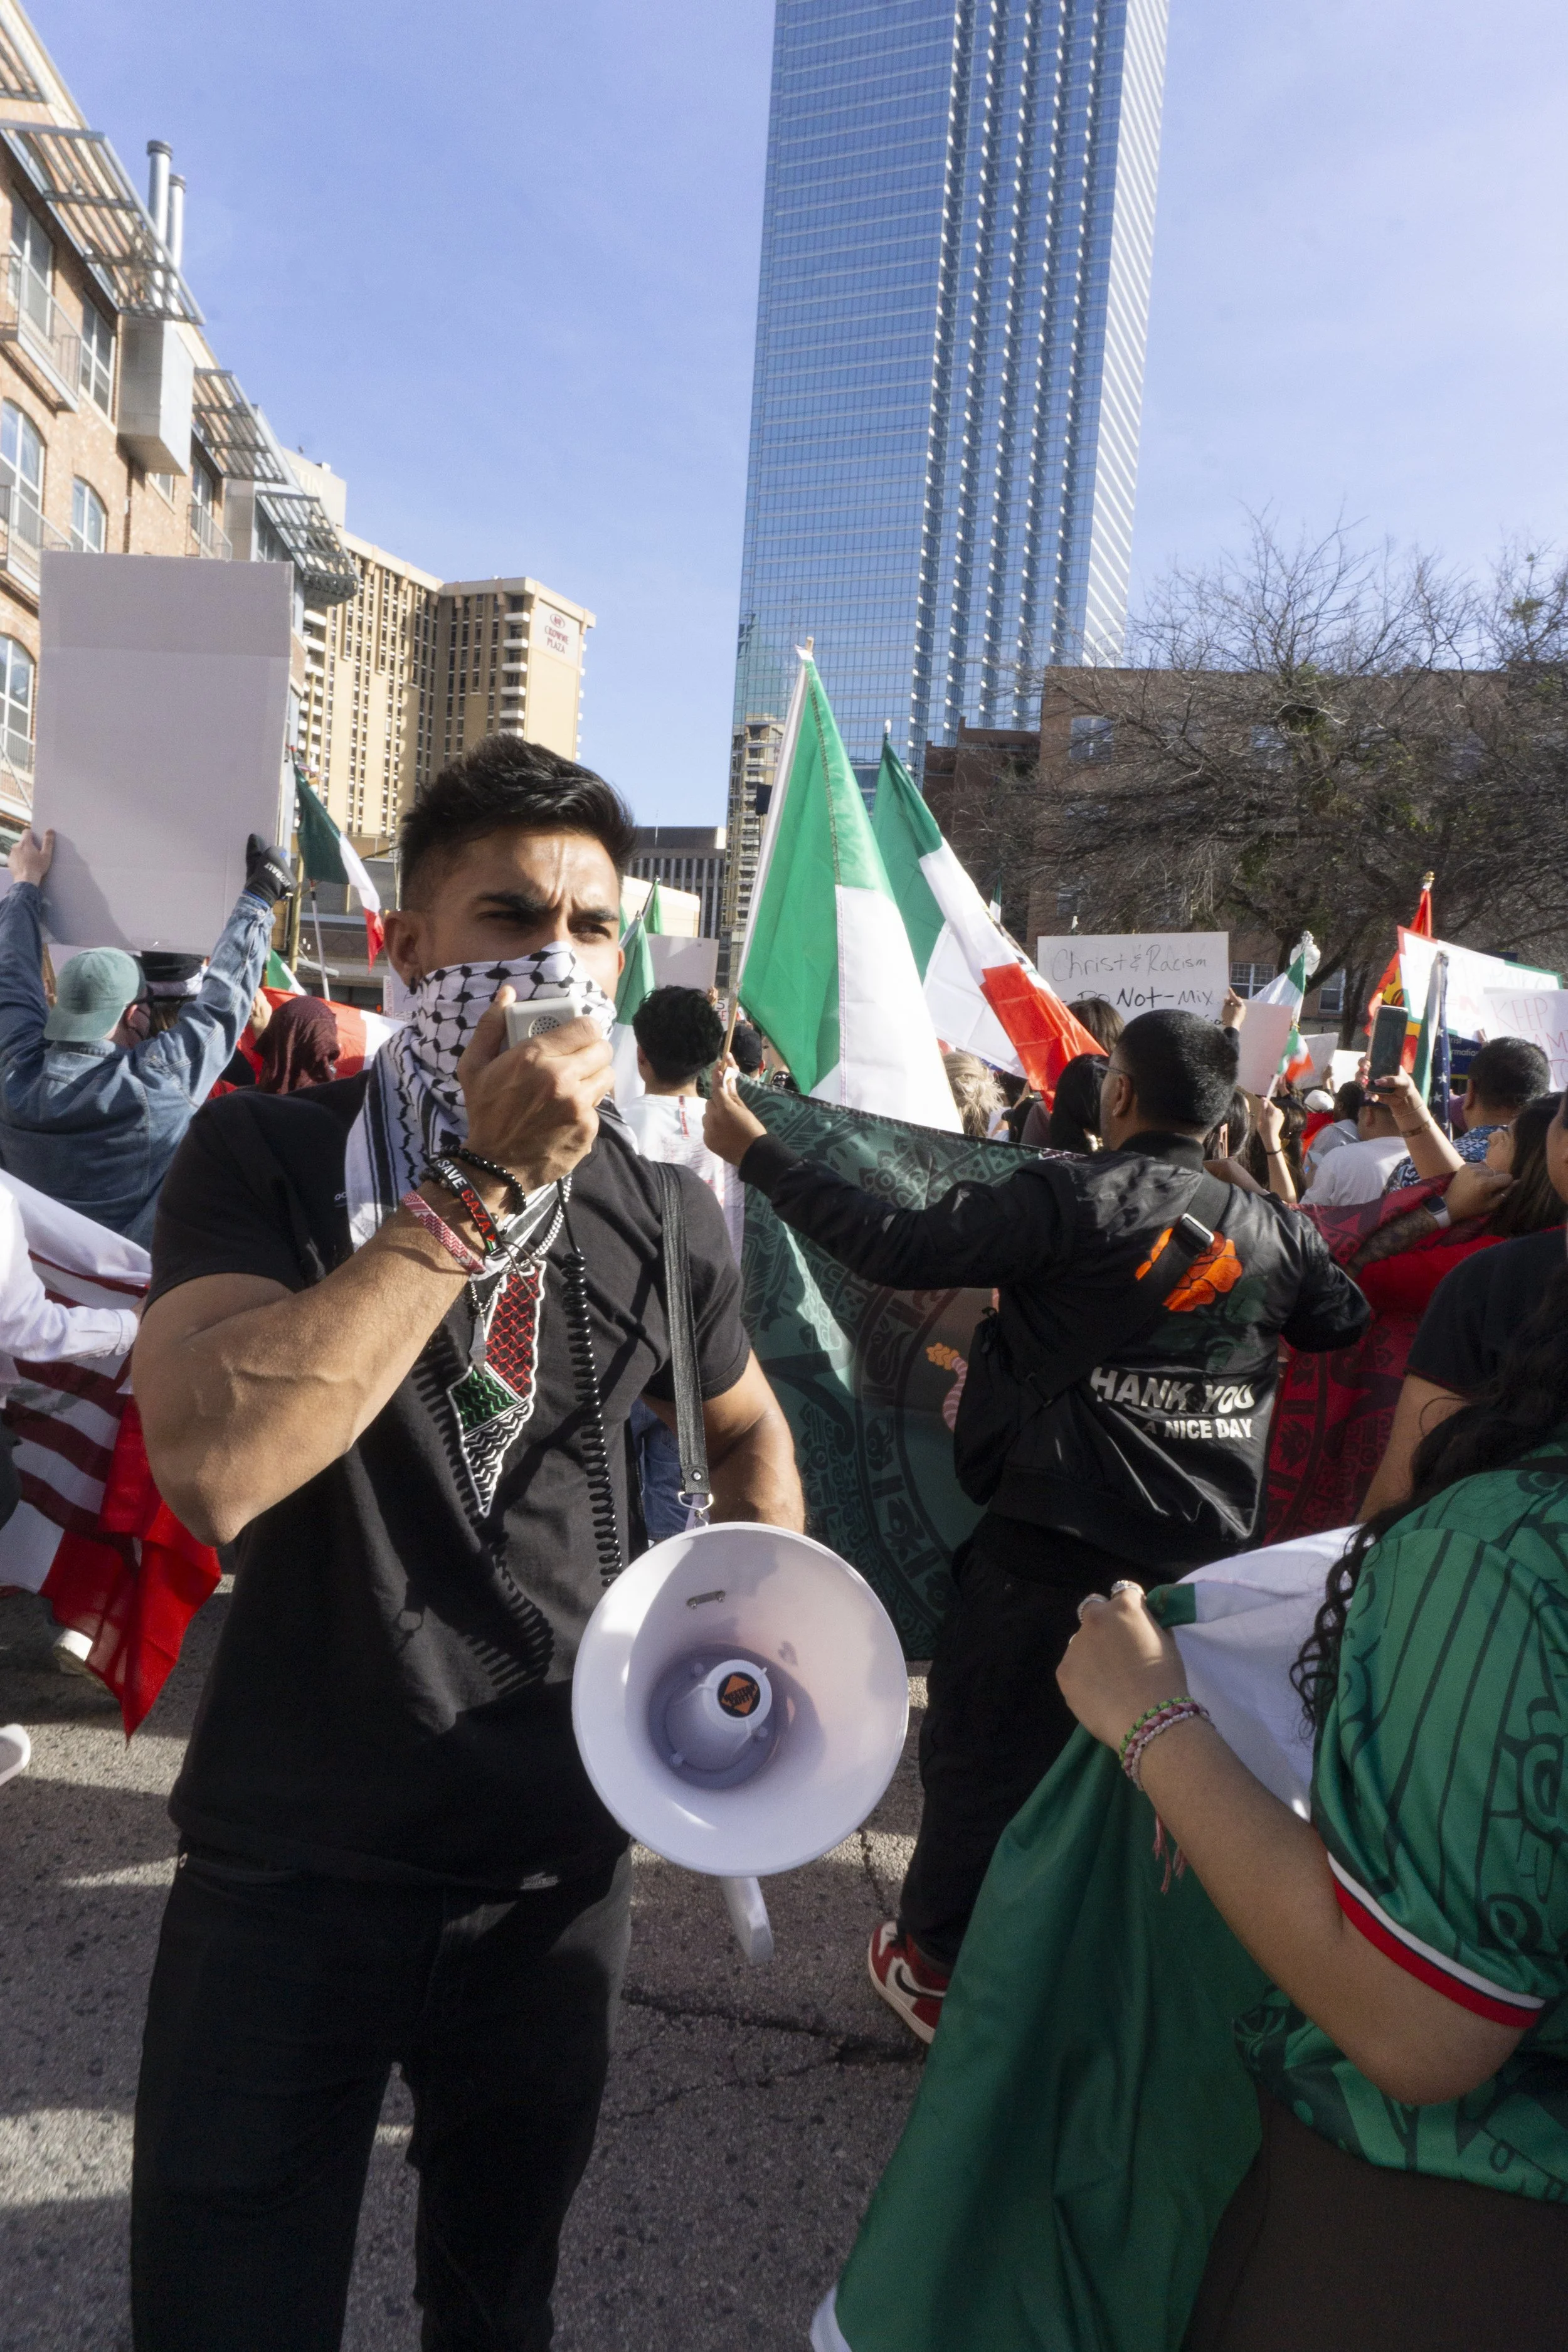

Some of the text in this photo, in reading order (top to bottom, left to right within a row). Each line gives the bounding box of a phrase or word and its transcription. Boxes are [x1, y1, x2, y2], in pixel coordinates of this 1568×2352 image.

[544, 625, 569, 645] CROWNE
[547, 637, 566, 654] PLAZA
[1052, 948, 1126, 982] Christ
[1146, 944, 1207, 975] Racism
[1491, 997, 1548, 1033] KEEP
[437, 1159, 467, 1190] SAVE
[461, 1189, 492, 1233] GAZA
[1091, 1367, 1254, 1414] HANK YOU
[1142, 1418, 1252, 1439] A NICE DAY
